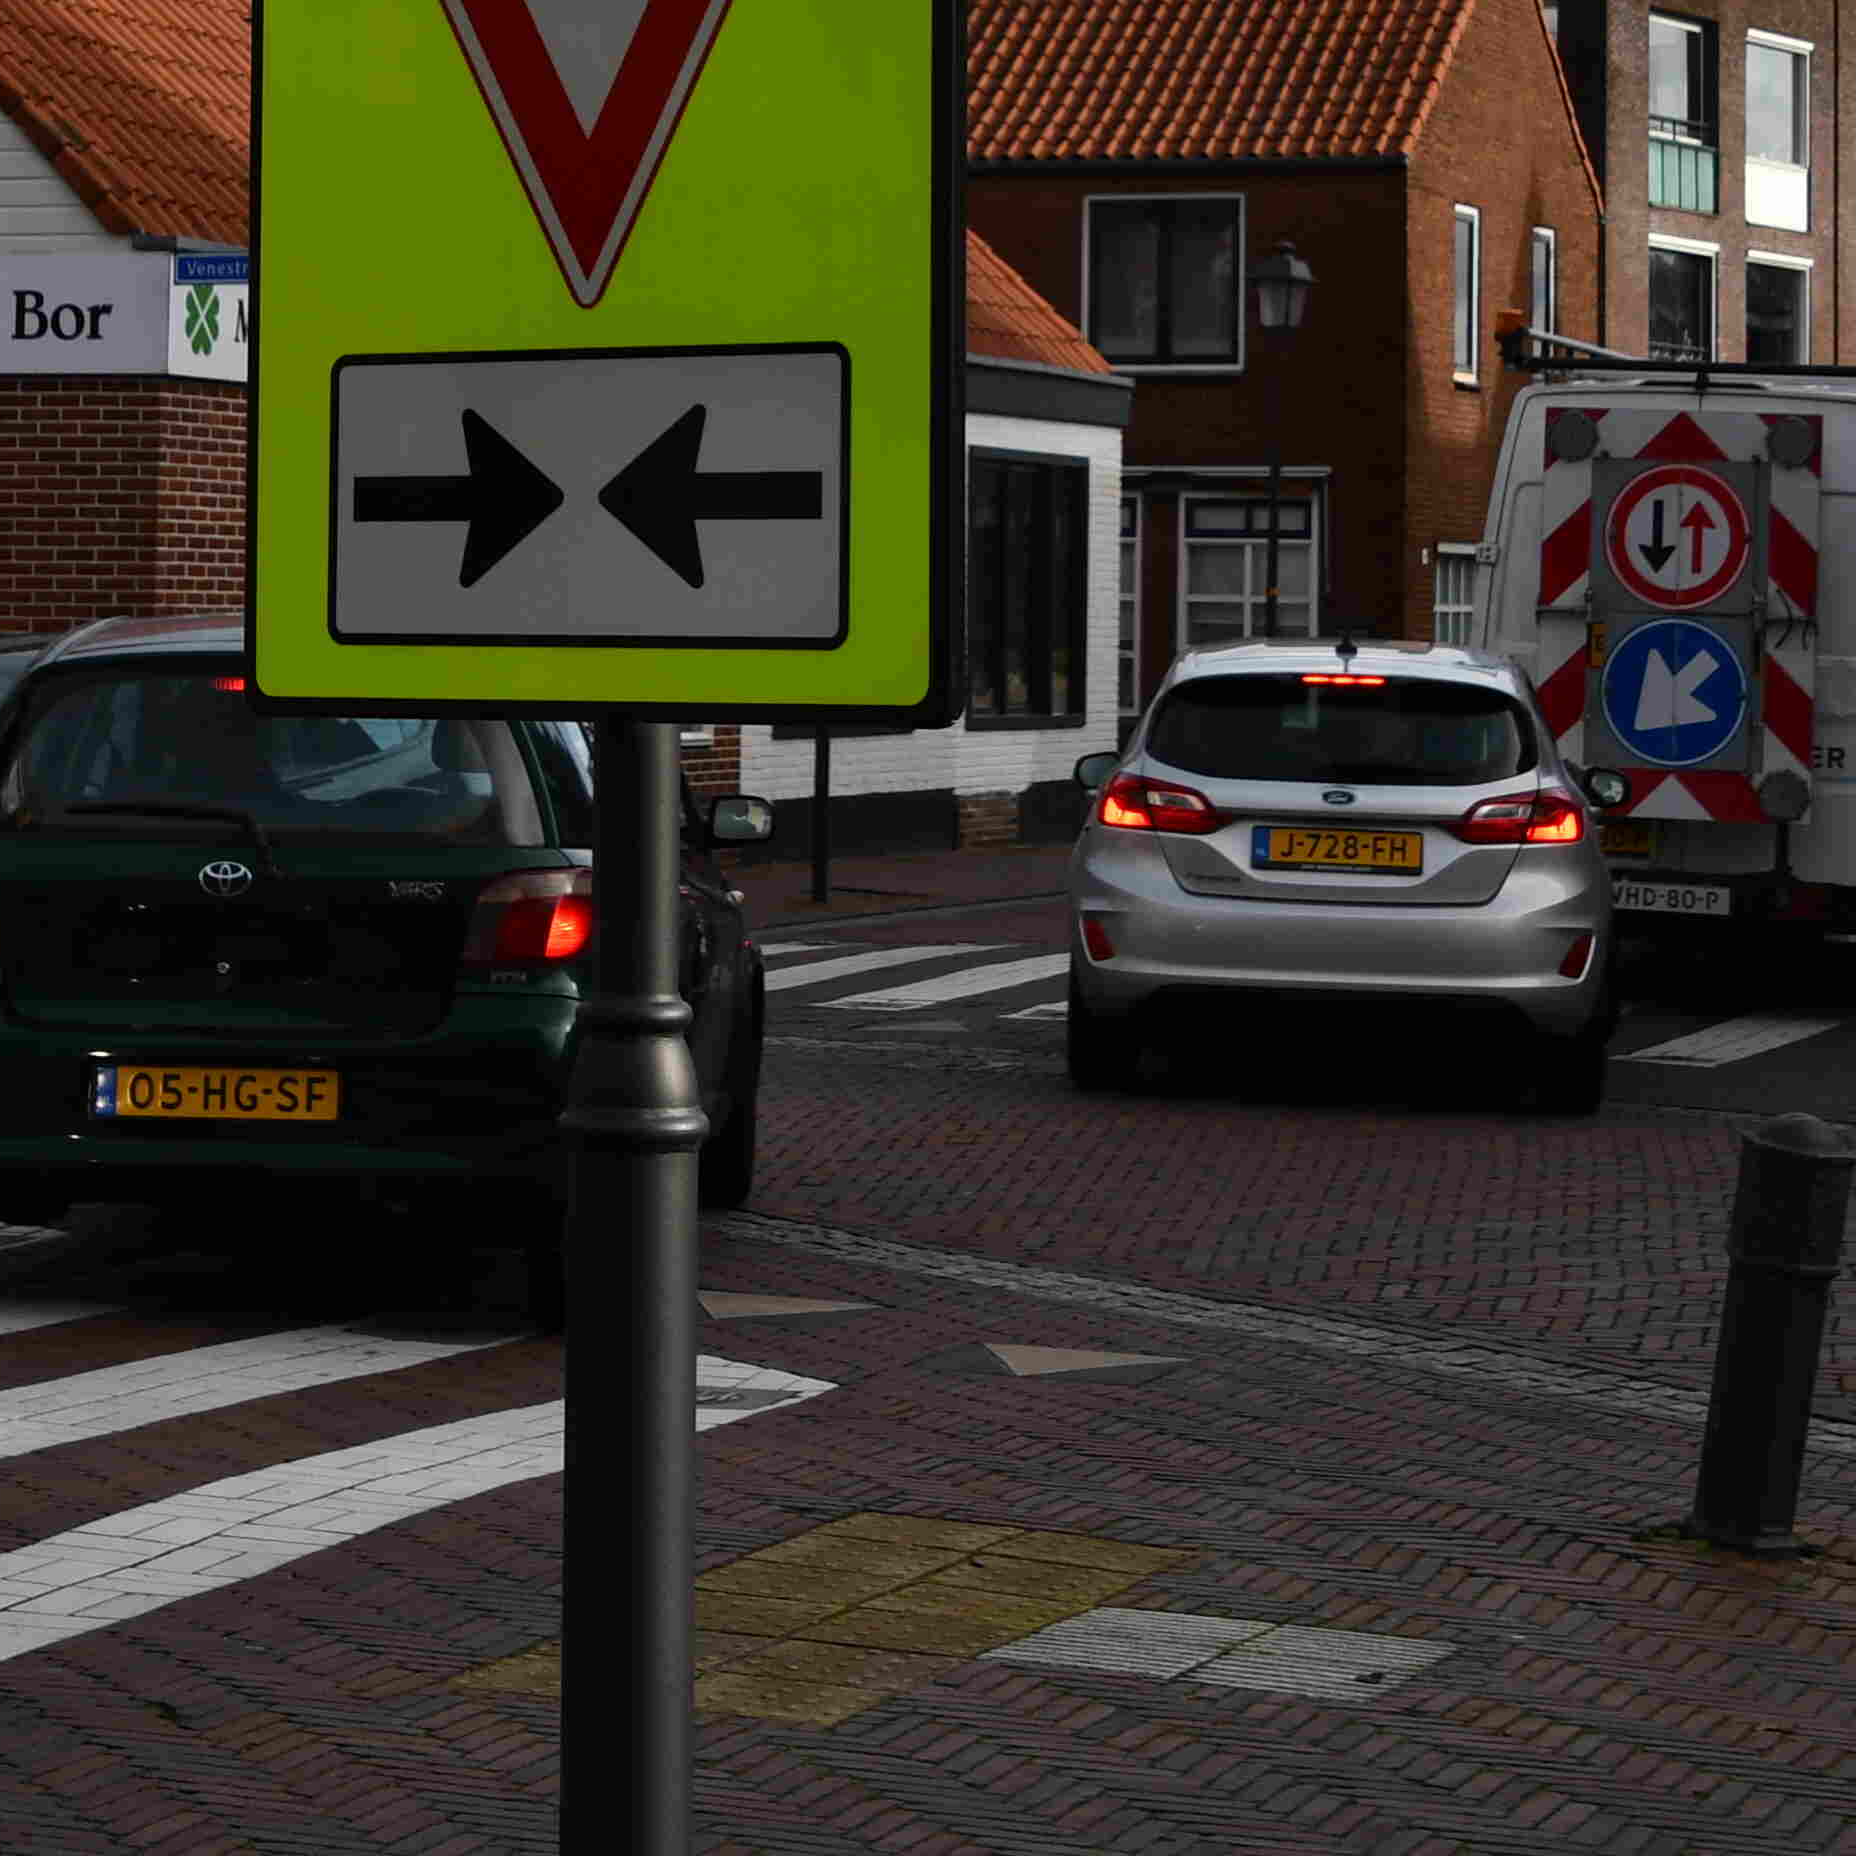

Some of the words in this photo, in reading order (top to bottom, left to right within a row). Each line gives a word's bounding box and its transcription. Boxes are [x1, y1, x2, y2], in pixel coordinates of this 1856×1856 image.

[11, 290, 112, 340] Bor
[1280, 831, 1407, 864] J-728-FH
[128, 1071, 327, 1113] 05-HG-SF
